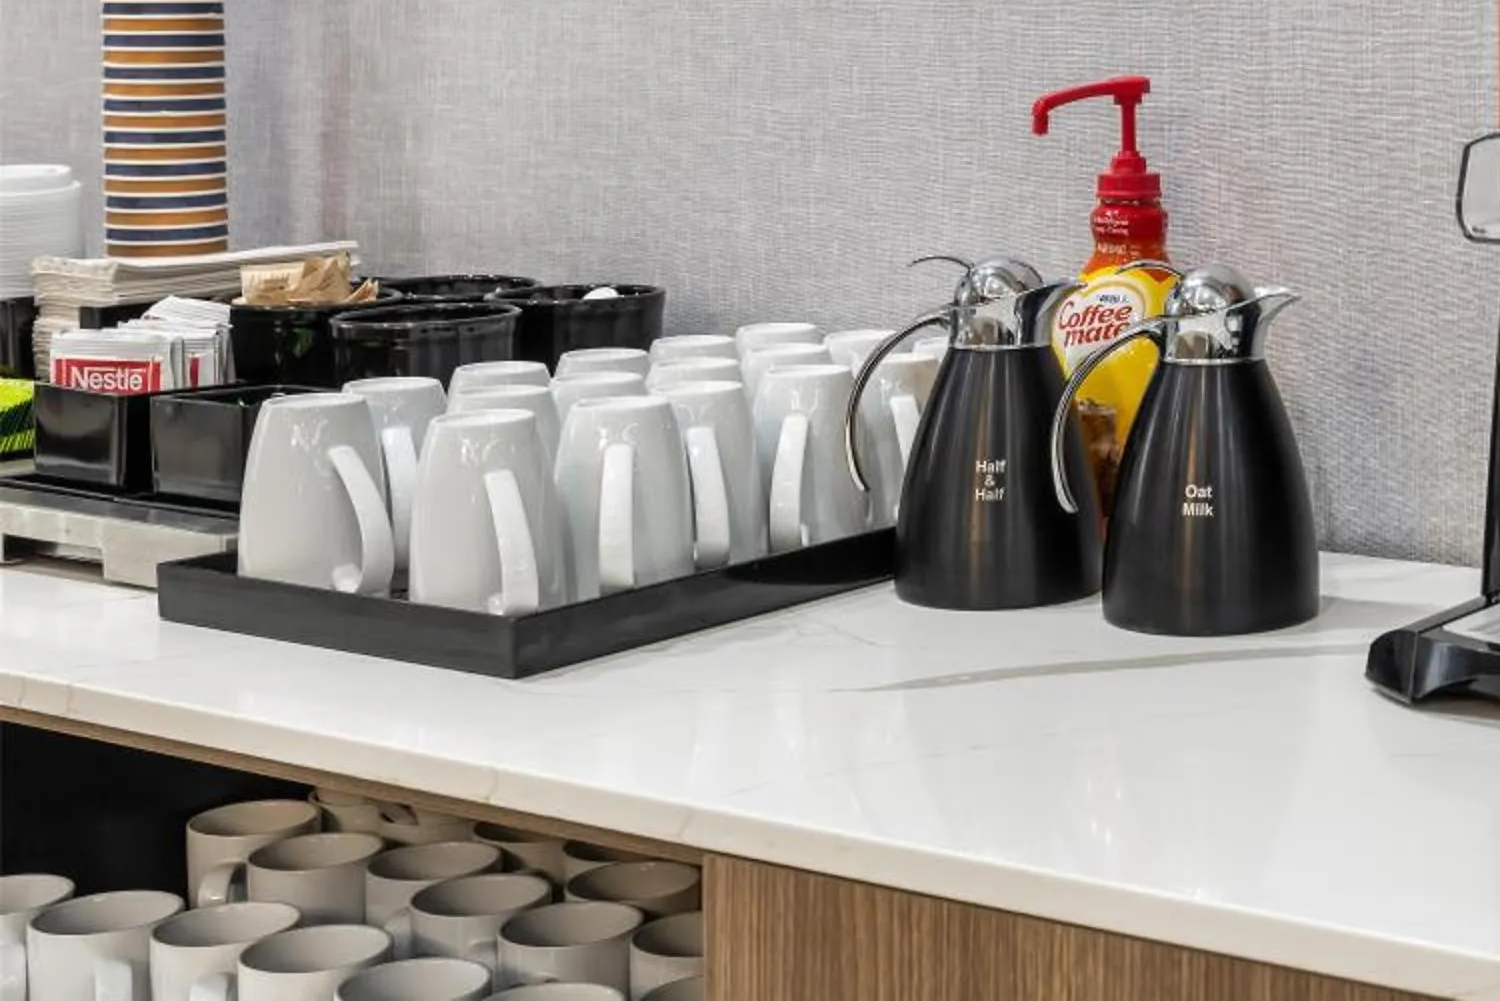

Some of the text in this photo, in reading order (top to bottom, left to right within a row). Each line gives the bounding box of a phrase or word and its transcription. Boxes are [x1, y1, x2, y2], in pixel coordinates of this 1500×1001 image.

[1058, 300, 1133, 330] Coffee
[975, 460, 1007, 474] Half
[984, 475, 996, 487] &
[975, 488, 1006, 502] Half
[1185, 483, 1213, 499] Oat
[1182, 502, 1214, 517] Milk
